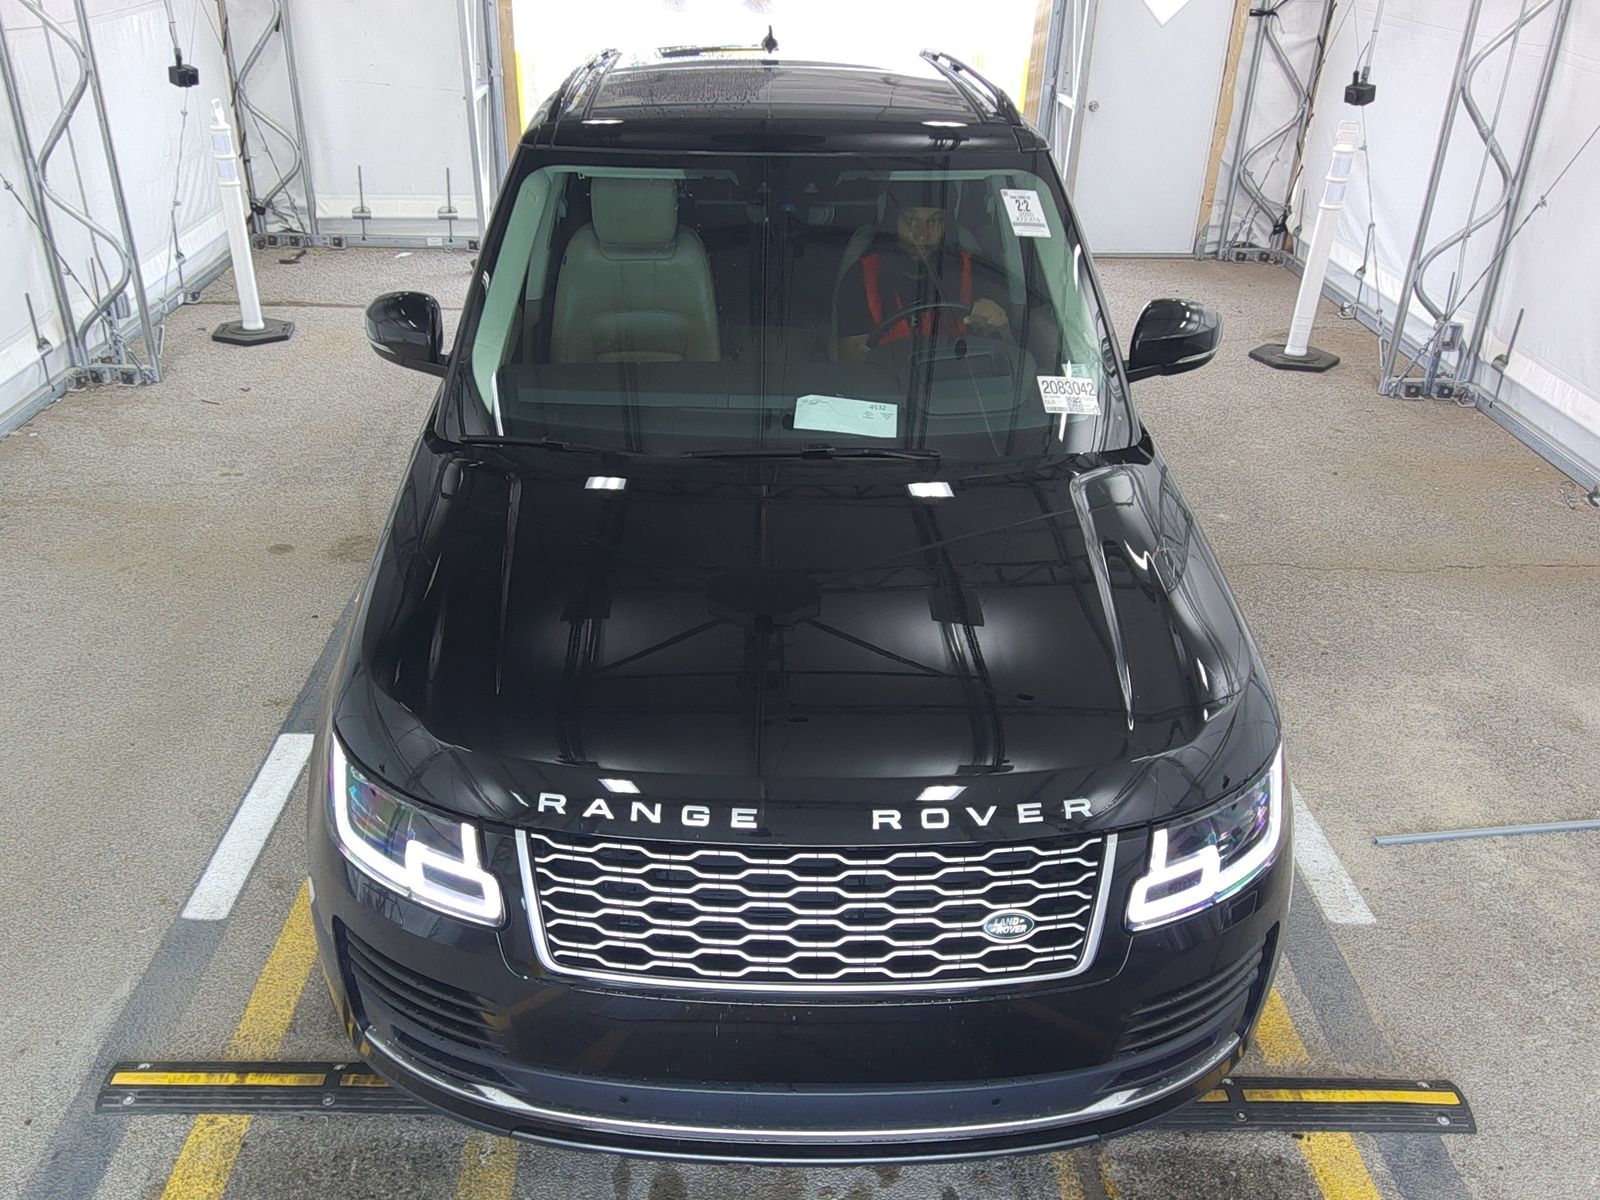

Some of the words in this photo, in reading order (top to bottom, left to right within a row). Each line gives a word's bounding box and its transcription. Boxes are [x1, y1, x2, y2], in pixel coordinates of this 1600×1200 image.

[1041, 379, 1097, 396] 2083042
[537, 791, 759, 830] RANGE
[872, 797, 1094, 830] ROVER
[994, 917, 1019, 926] LAND
[995, 924, 1028, 934] ROVER
